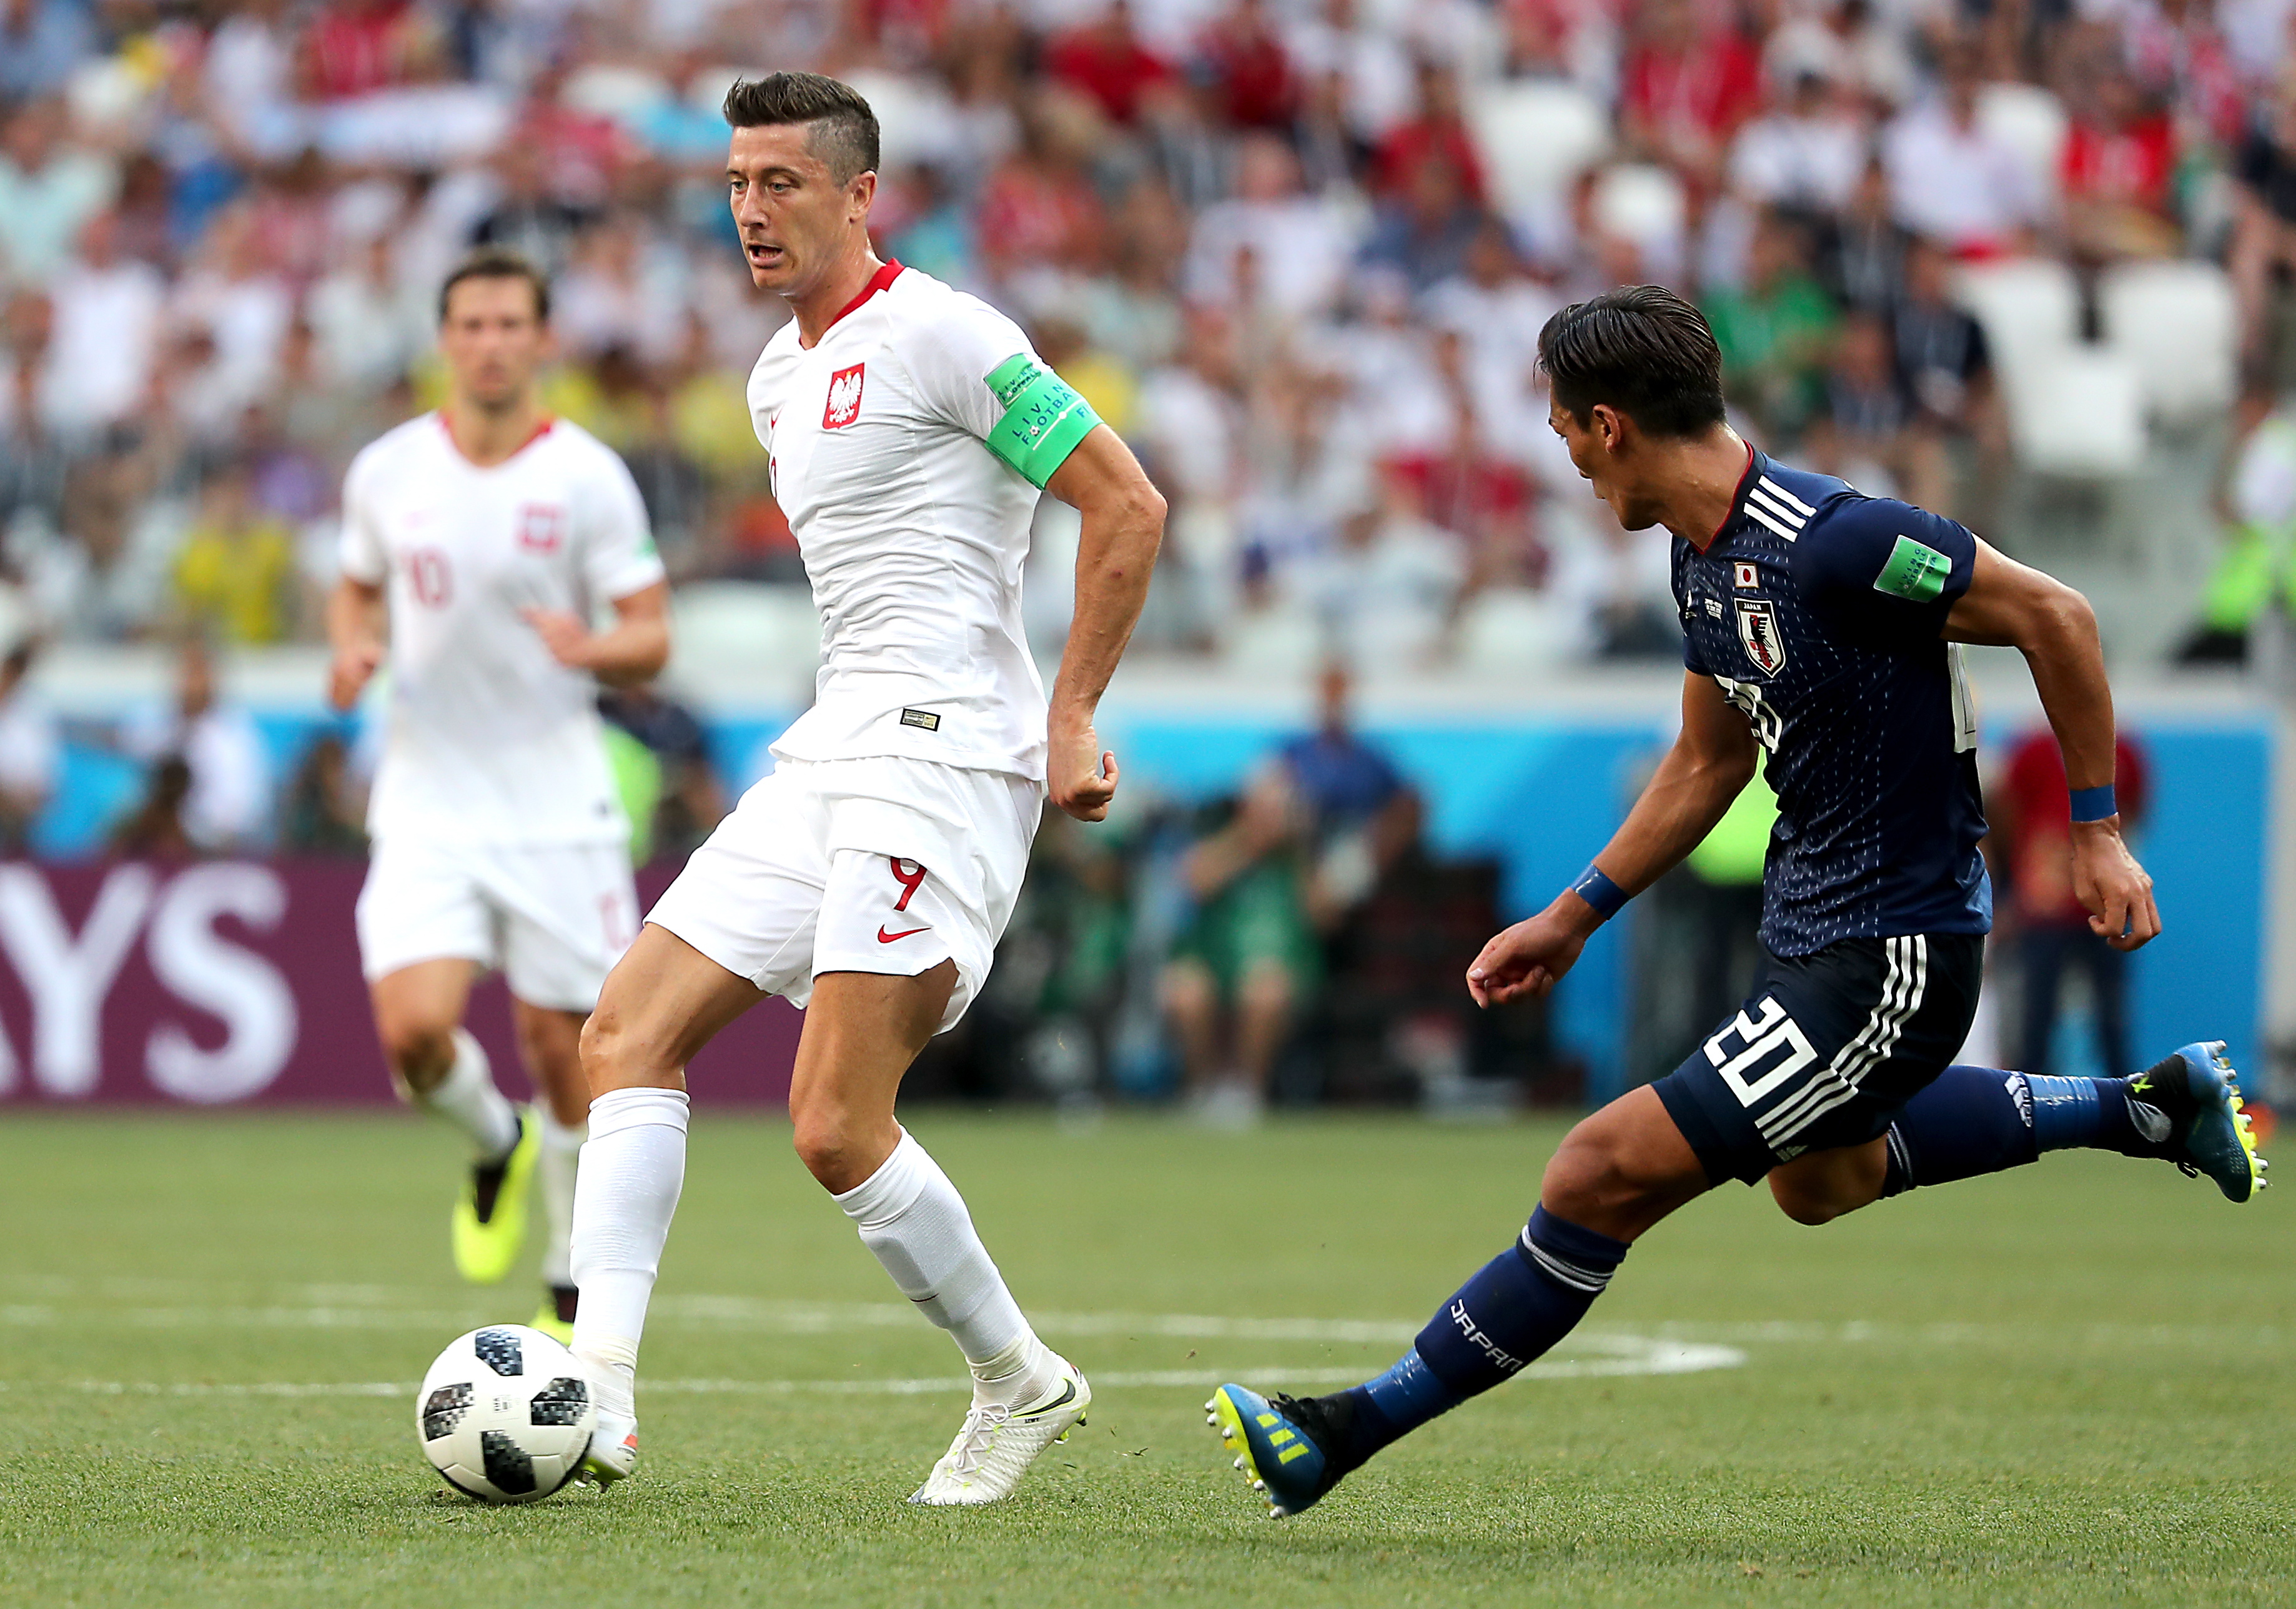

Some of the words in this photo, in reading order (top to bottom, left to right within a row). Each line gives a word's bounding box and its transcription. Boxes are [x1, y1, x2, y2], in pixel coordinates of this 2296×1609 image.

[1012, 384, 1064, 437] LIVIN
[1021, 391, 1072, 445] FOOTBA
[1076, 406, 1091, 418] FI
[890, 856, 928, 911] 9
[0, 859, 300, 1104] YS
[1703, 996, 1818, 1108] 20
[1450, 1299, 1523, 1372] JAPAN
